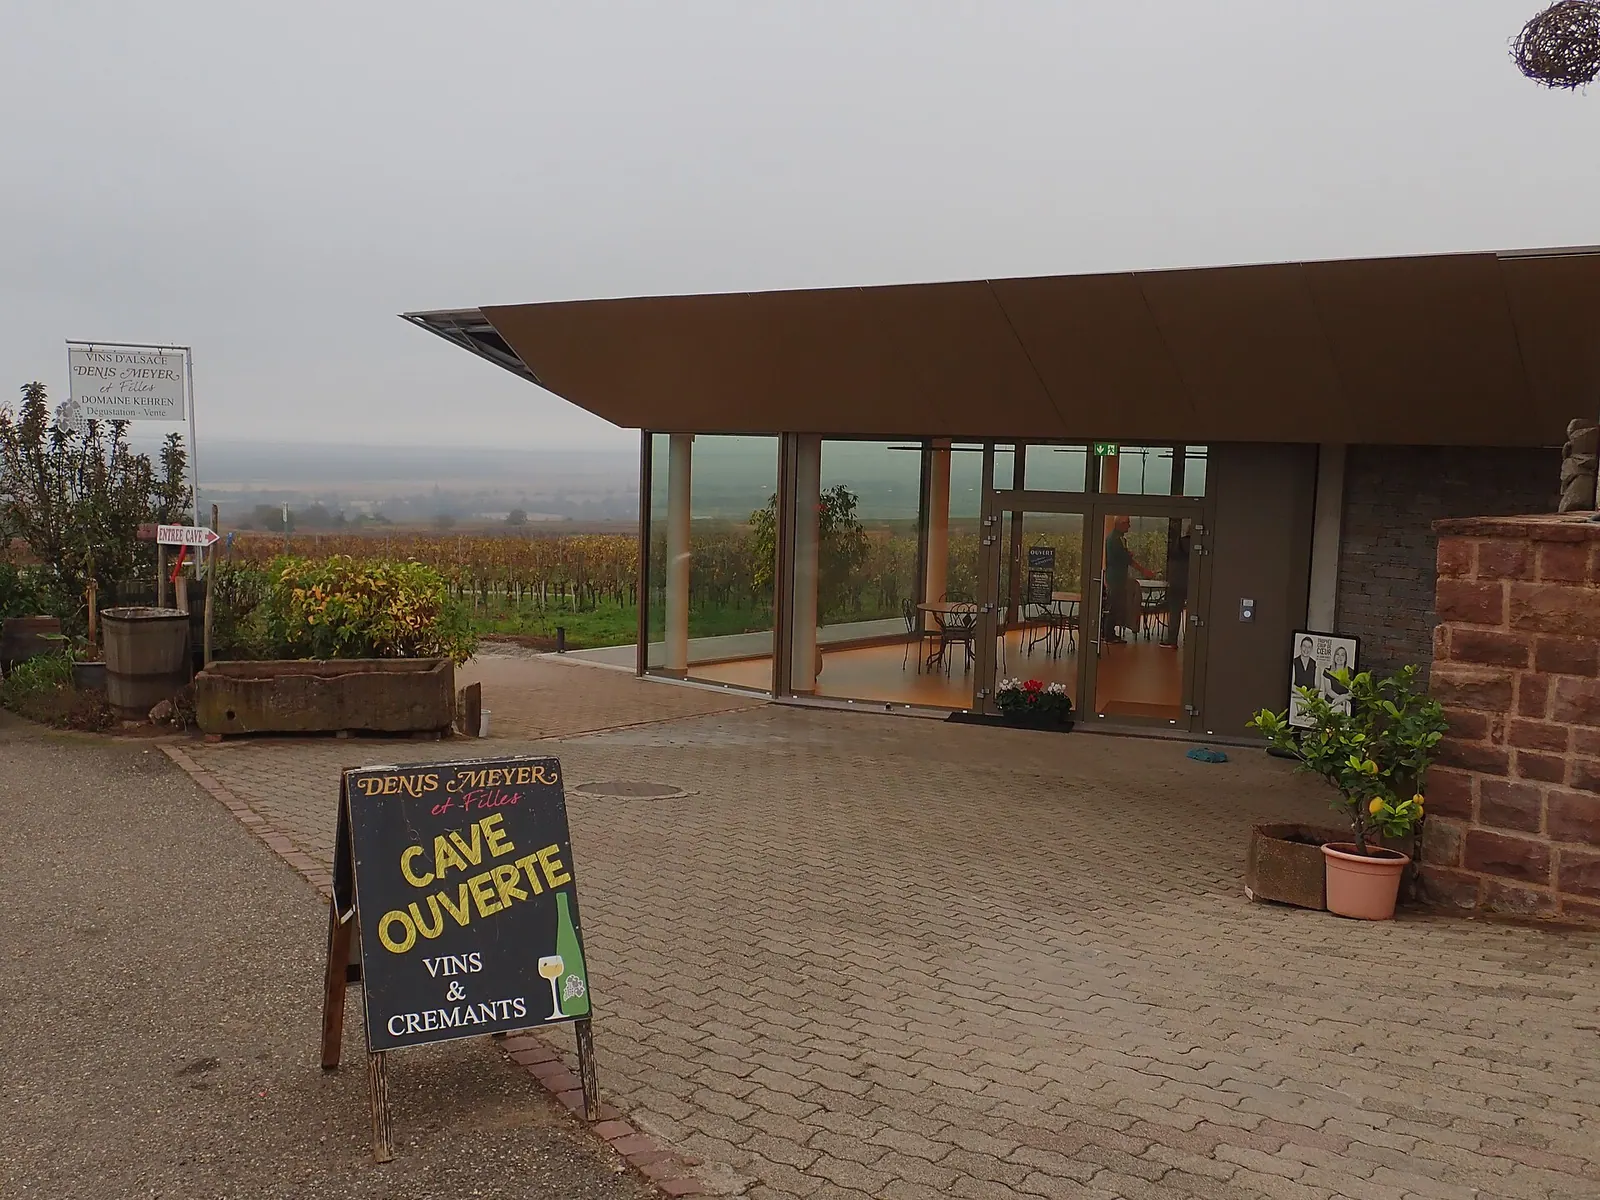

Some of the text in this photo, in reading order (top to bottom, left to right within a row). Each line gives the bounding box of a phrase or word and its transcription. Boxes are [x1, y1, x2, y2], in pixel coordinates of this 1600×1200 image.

[86, 353, 168, 365] VINS D'ALSACE
[73, 366, 180, 381] DENIS MEYER
[99, 379, 156, 393] et Filles
[81, 395, 174, 406] DOMAINE KEHREN
[86, 406, 136, 417] Dégustation
[143, 408, 166, 417] Vente
[185, 529, 203, 543] CAVE
[357, 766, 558, 798] DENIS MEYER
[430, 789, 522, 816] et Filles
[400, 812, 515, 888] CAVE
[378, 843, 571, 954] OUVERTE
[422, 952, 483, 978] VINS
[446, 980, 467, 1001] &
[387, 997, 527, 1036] CREMANTS
